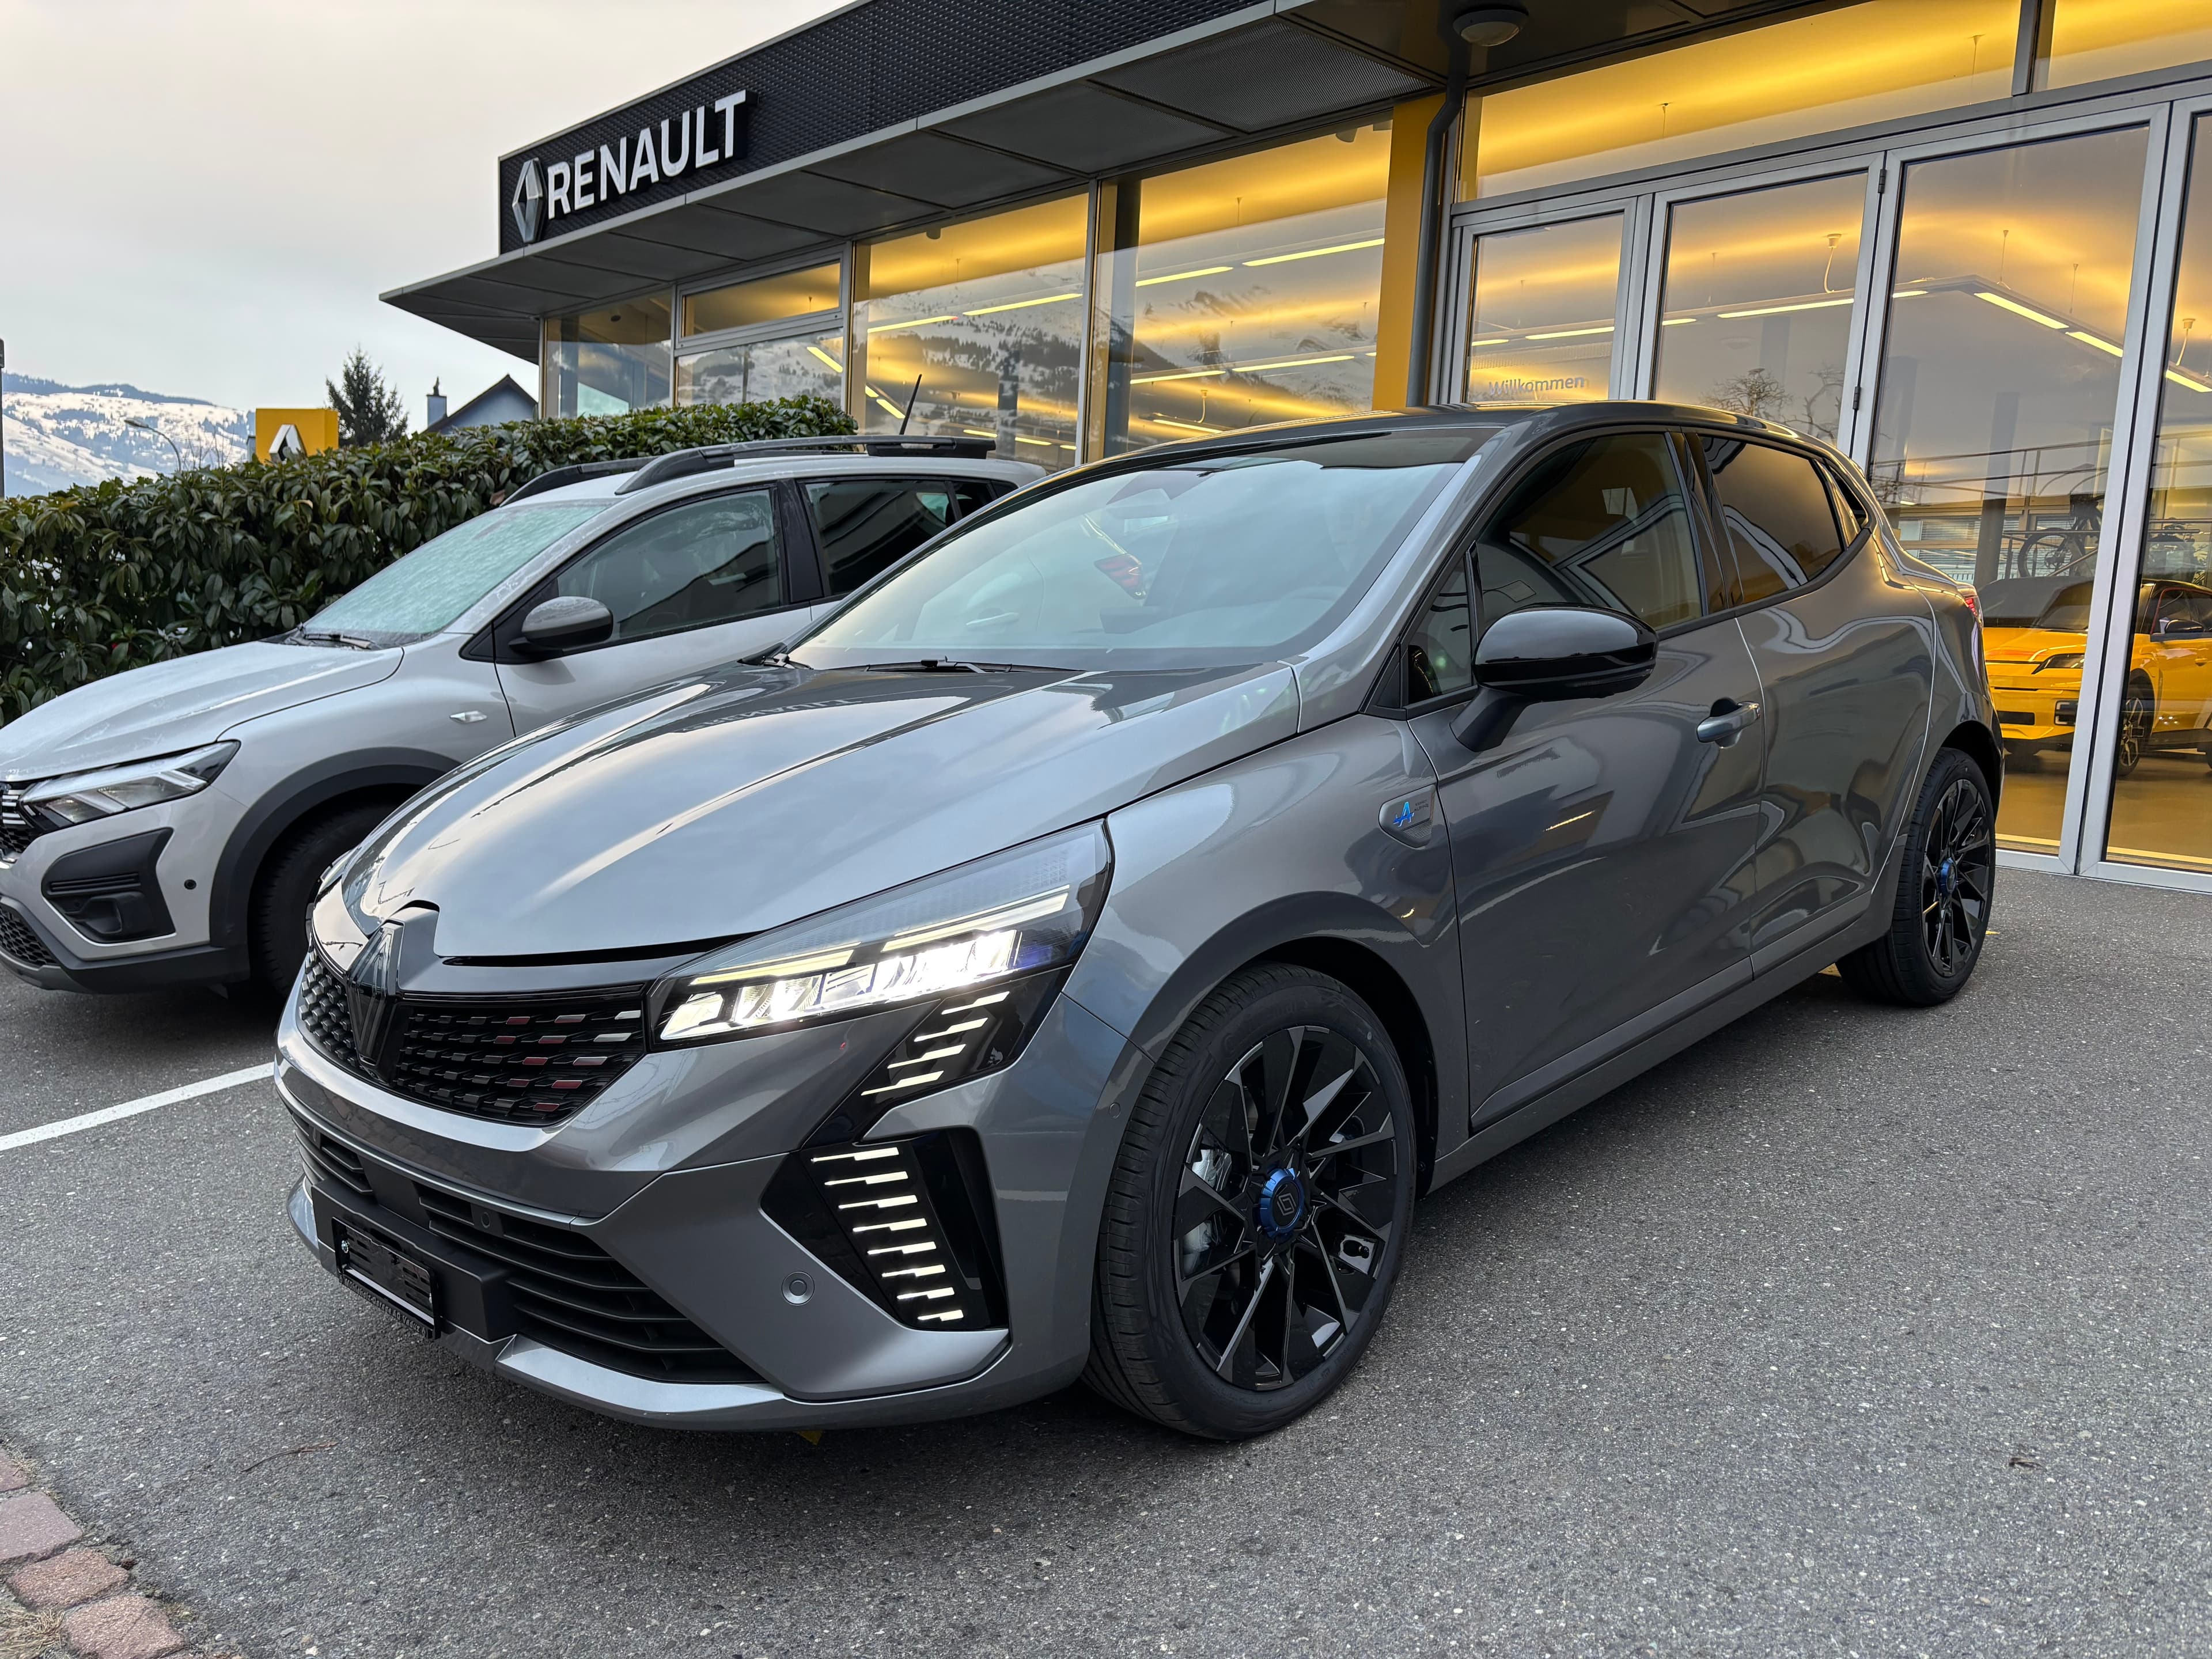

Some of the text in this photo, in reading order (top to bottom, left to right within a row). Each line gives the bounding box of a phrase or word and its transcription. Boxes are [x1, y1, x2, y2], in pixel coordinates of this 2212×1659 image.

[547, 89, 747, 220] RENAULT
[1488, 376, 1585, 396] Willkommen
[402, 1315, 421, 1332] Vaduz
